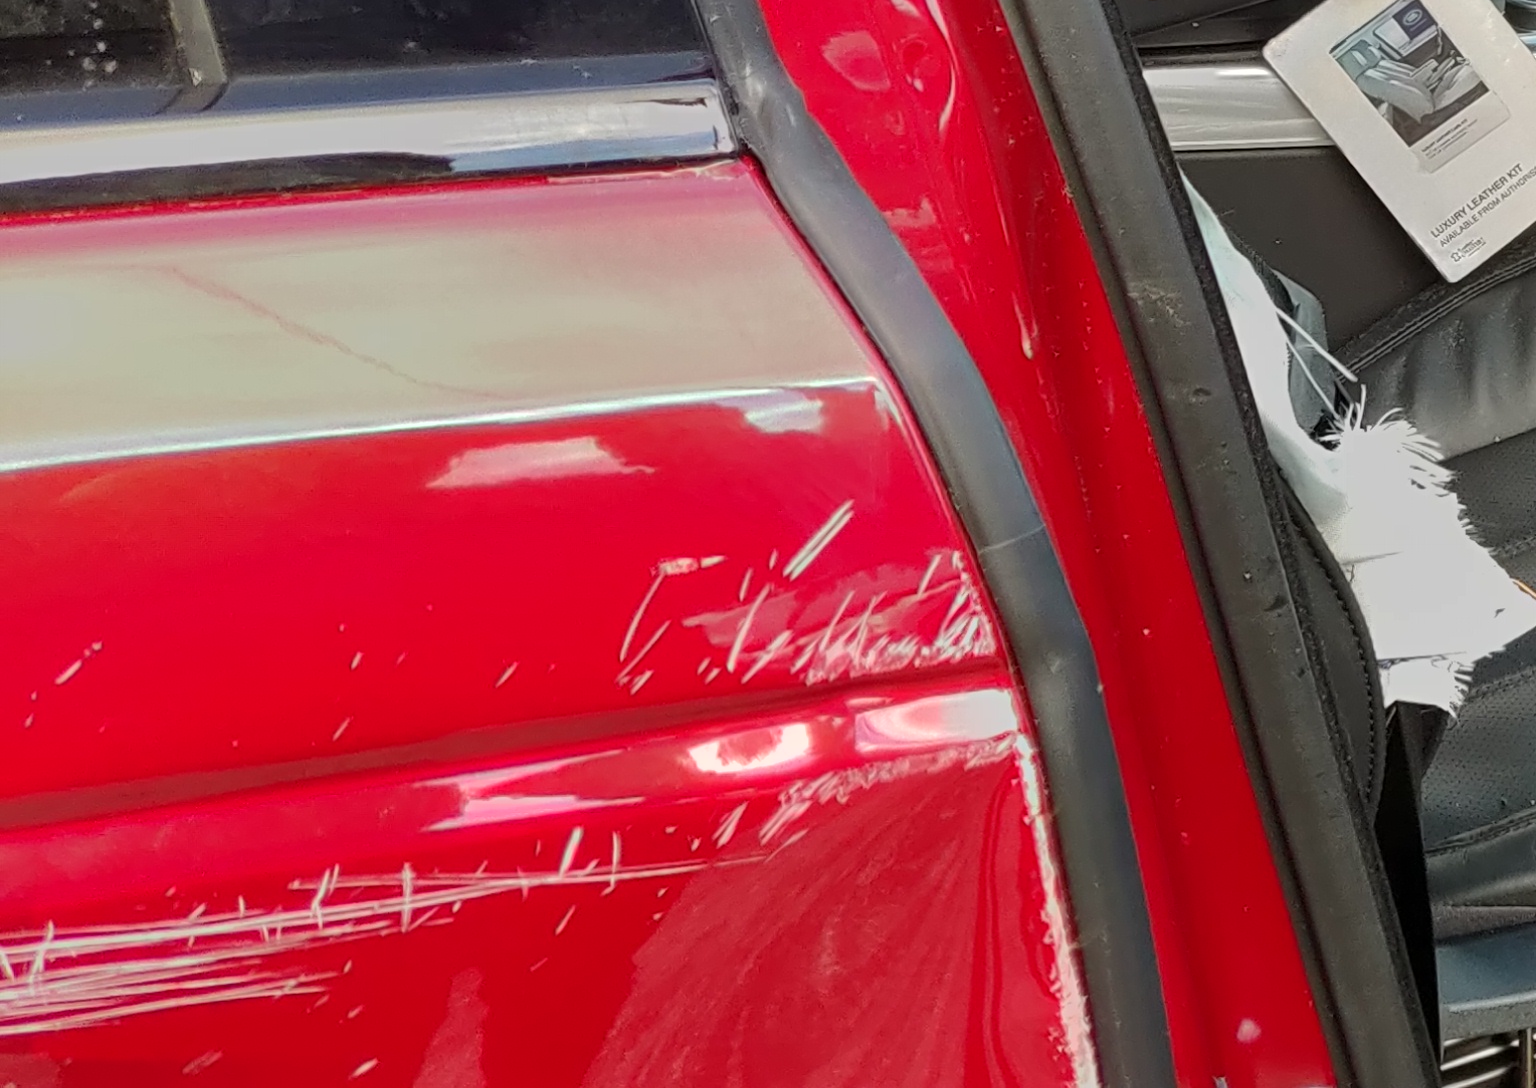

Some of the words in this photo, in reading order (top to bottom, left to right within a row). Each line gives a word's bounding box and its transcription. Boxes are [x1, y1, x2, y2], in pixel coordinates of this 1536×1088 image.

[1430, 206, 1467, 238] LUXURY
[1466, 176, 1508, 211] LEATHER
[1506, 163, 1523, 182] KIT
[1439, 215, 1480, 247] AVAILABLE
[1479, 196, 1501, 218] FROM
